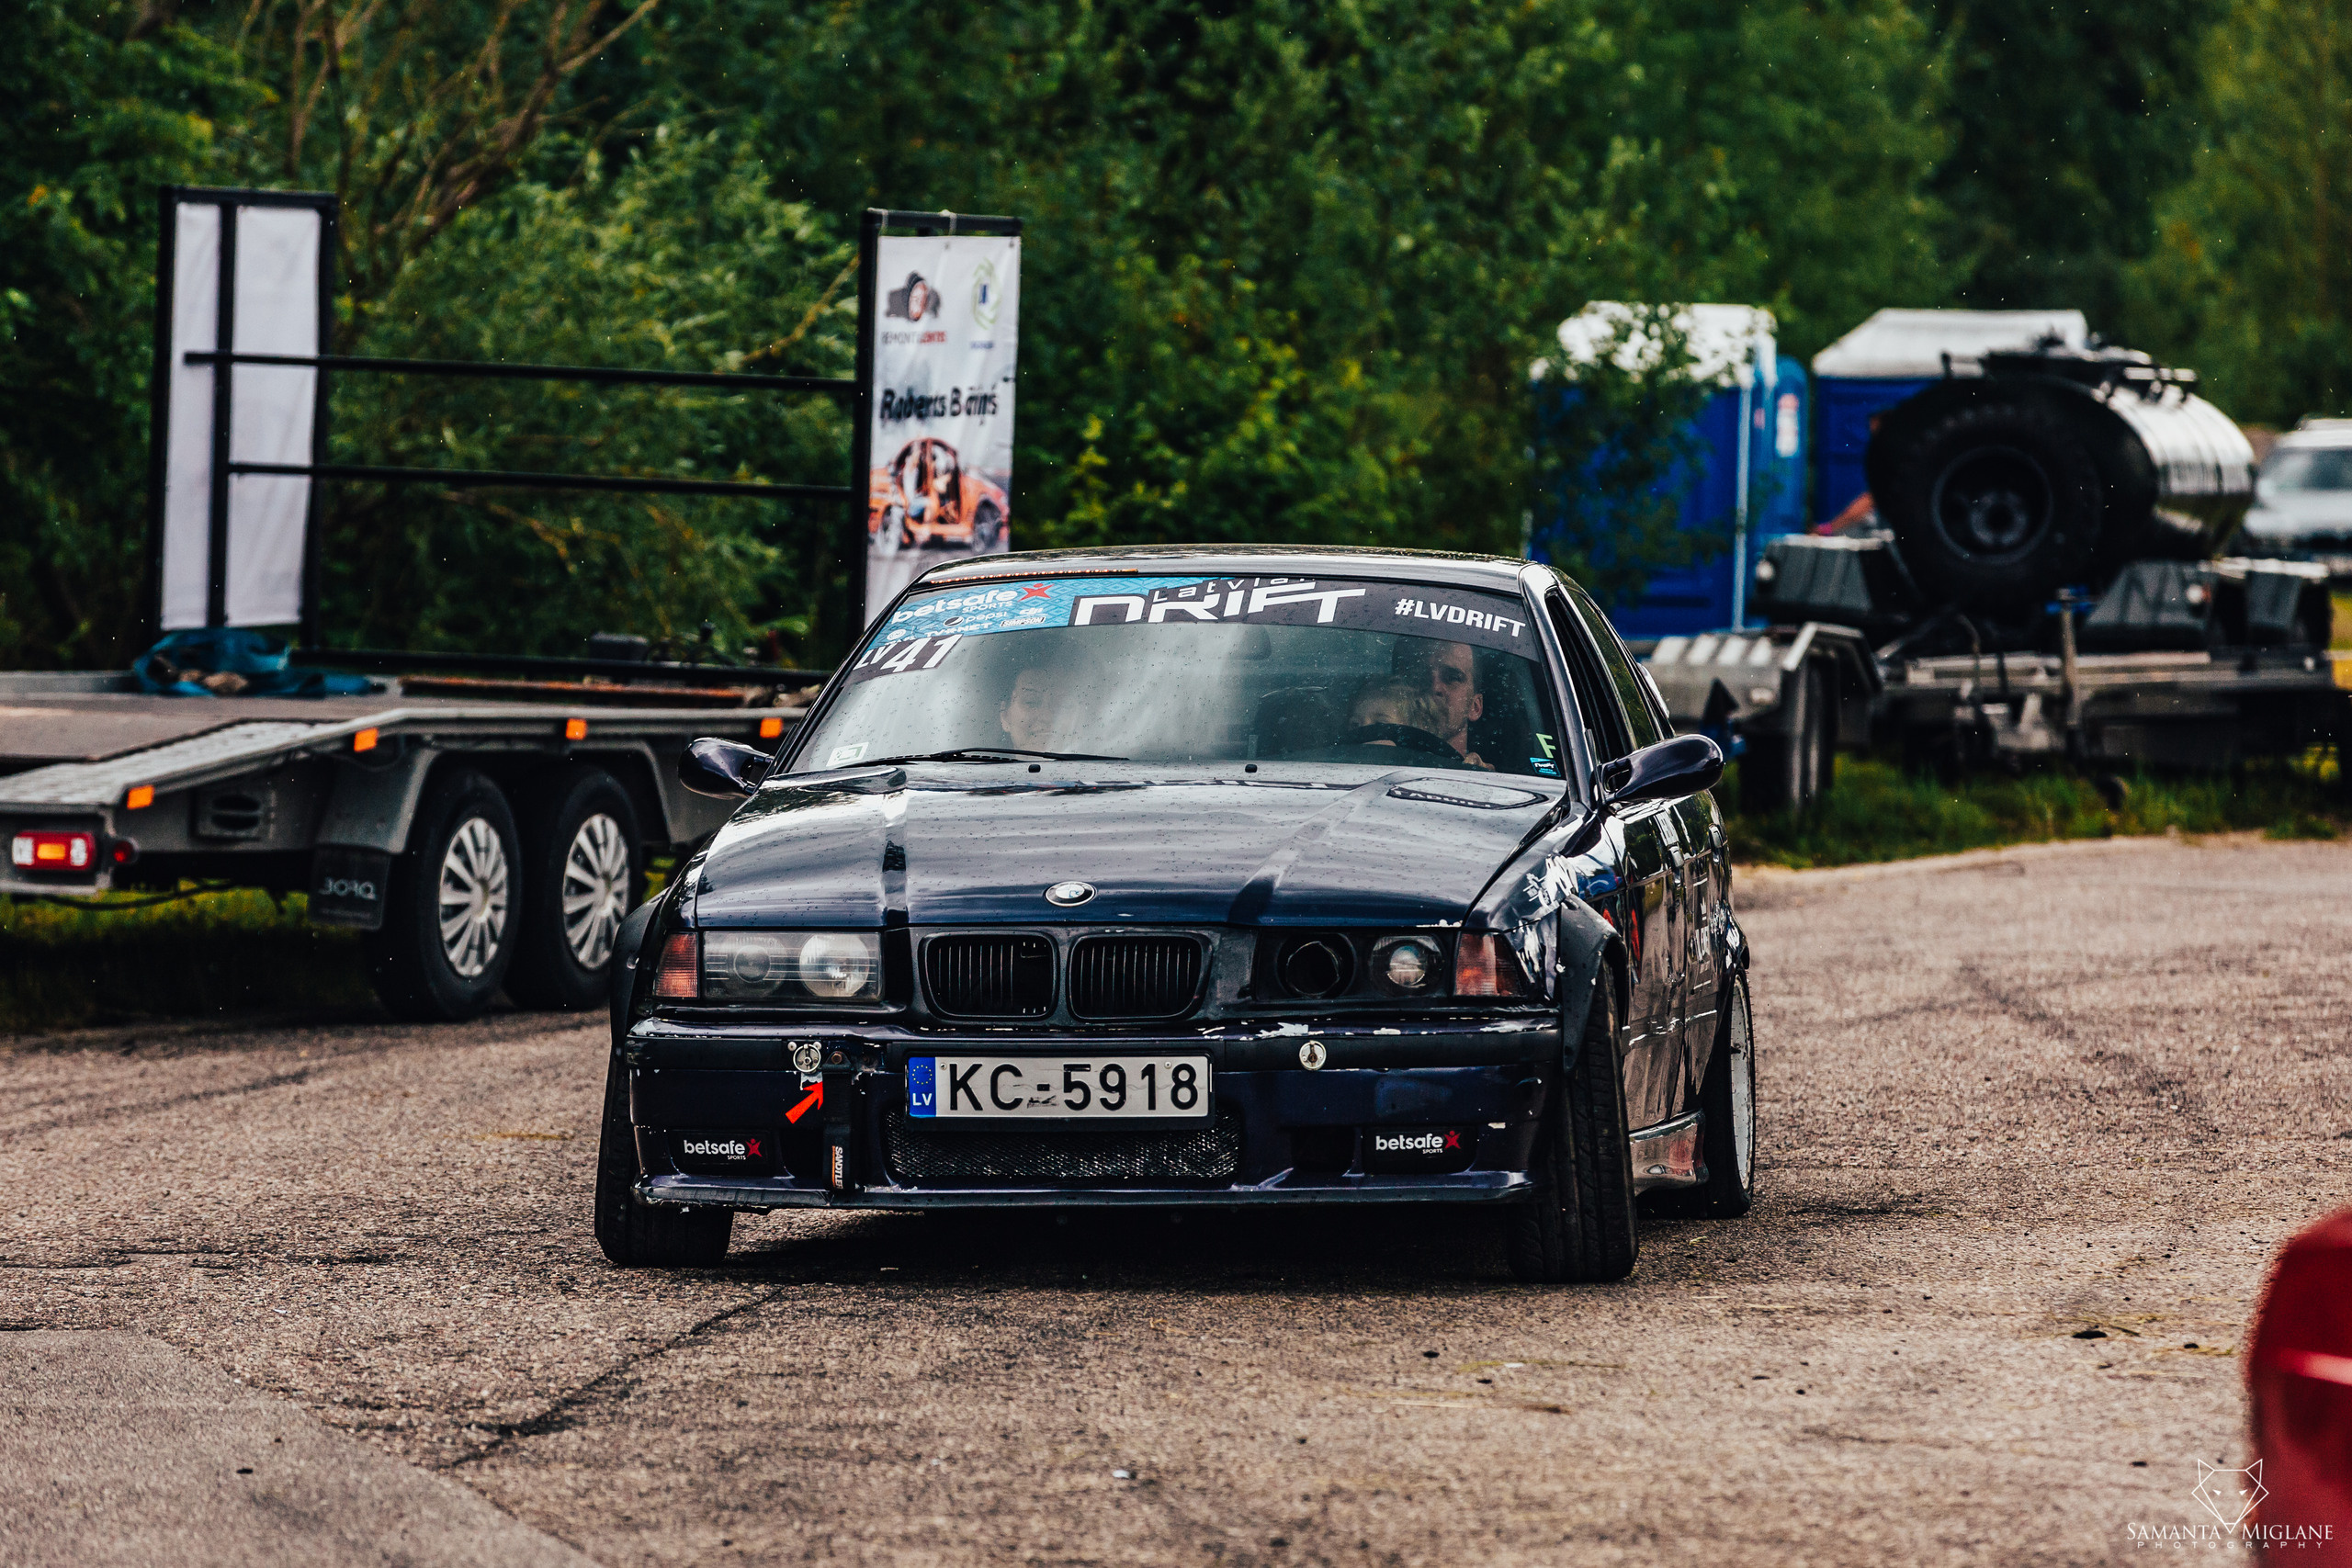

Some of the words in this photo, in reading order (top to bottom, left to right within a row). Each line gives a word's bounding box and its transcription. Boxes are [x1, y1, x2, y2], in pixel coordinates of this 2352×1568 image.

[1152, 577, 1316, 604] Latvia
[890, 589, 1018, 624] betsafe
[962, 600, 1013, 614] SPORTS
[965, 611, 1007, 624] pepsi
[1395, 598, 1526, 637] #LVDRIFT
[949, 1063, 1198, 1111] KC-5918
[912, 1092, 932, 1106] LV
[684, 1138, 746, 1156] betsafe
[1375, 1133, 1443, 1151] betsafe
